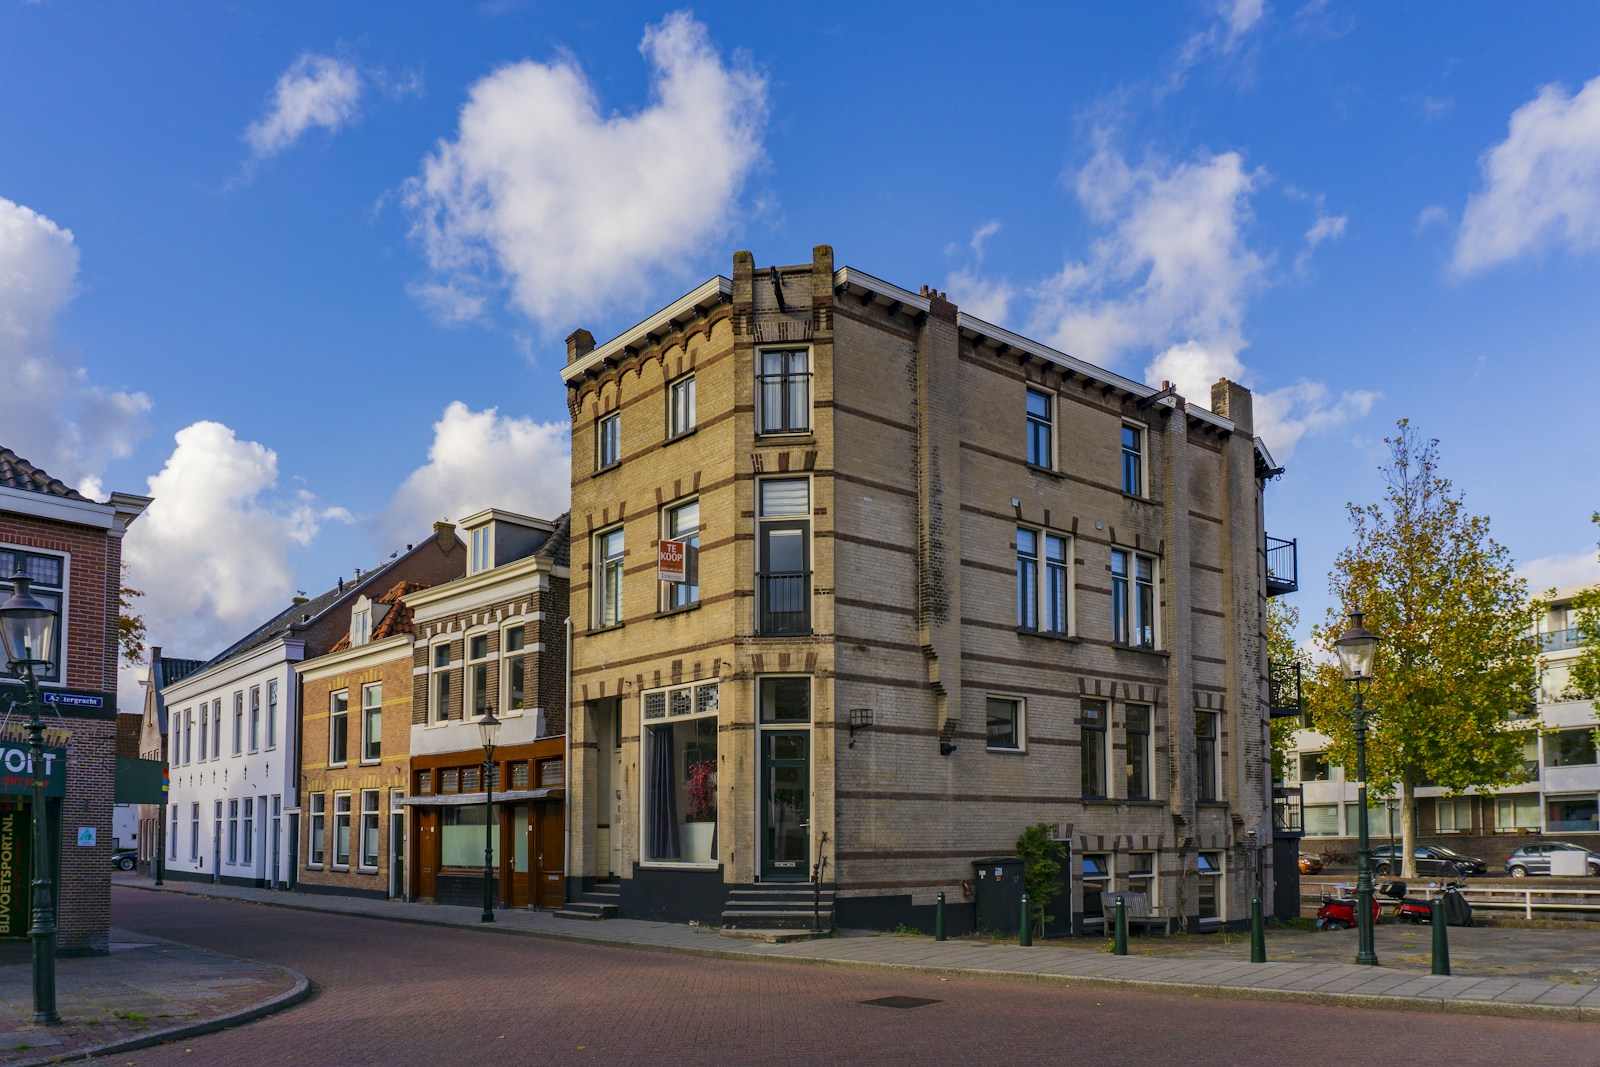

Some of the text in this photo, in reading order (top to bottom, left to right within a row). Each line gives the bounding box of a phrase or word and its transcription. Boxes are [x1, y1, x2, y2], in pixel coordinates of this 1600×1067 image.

[667, 544, 676, 553] TE
[660, 552, 682, 562] KOOP
[0, 813, 13, 933] BIJVOETSPORT.NL
